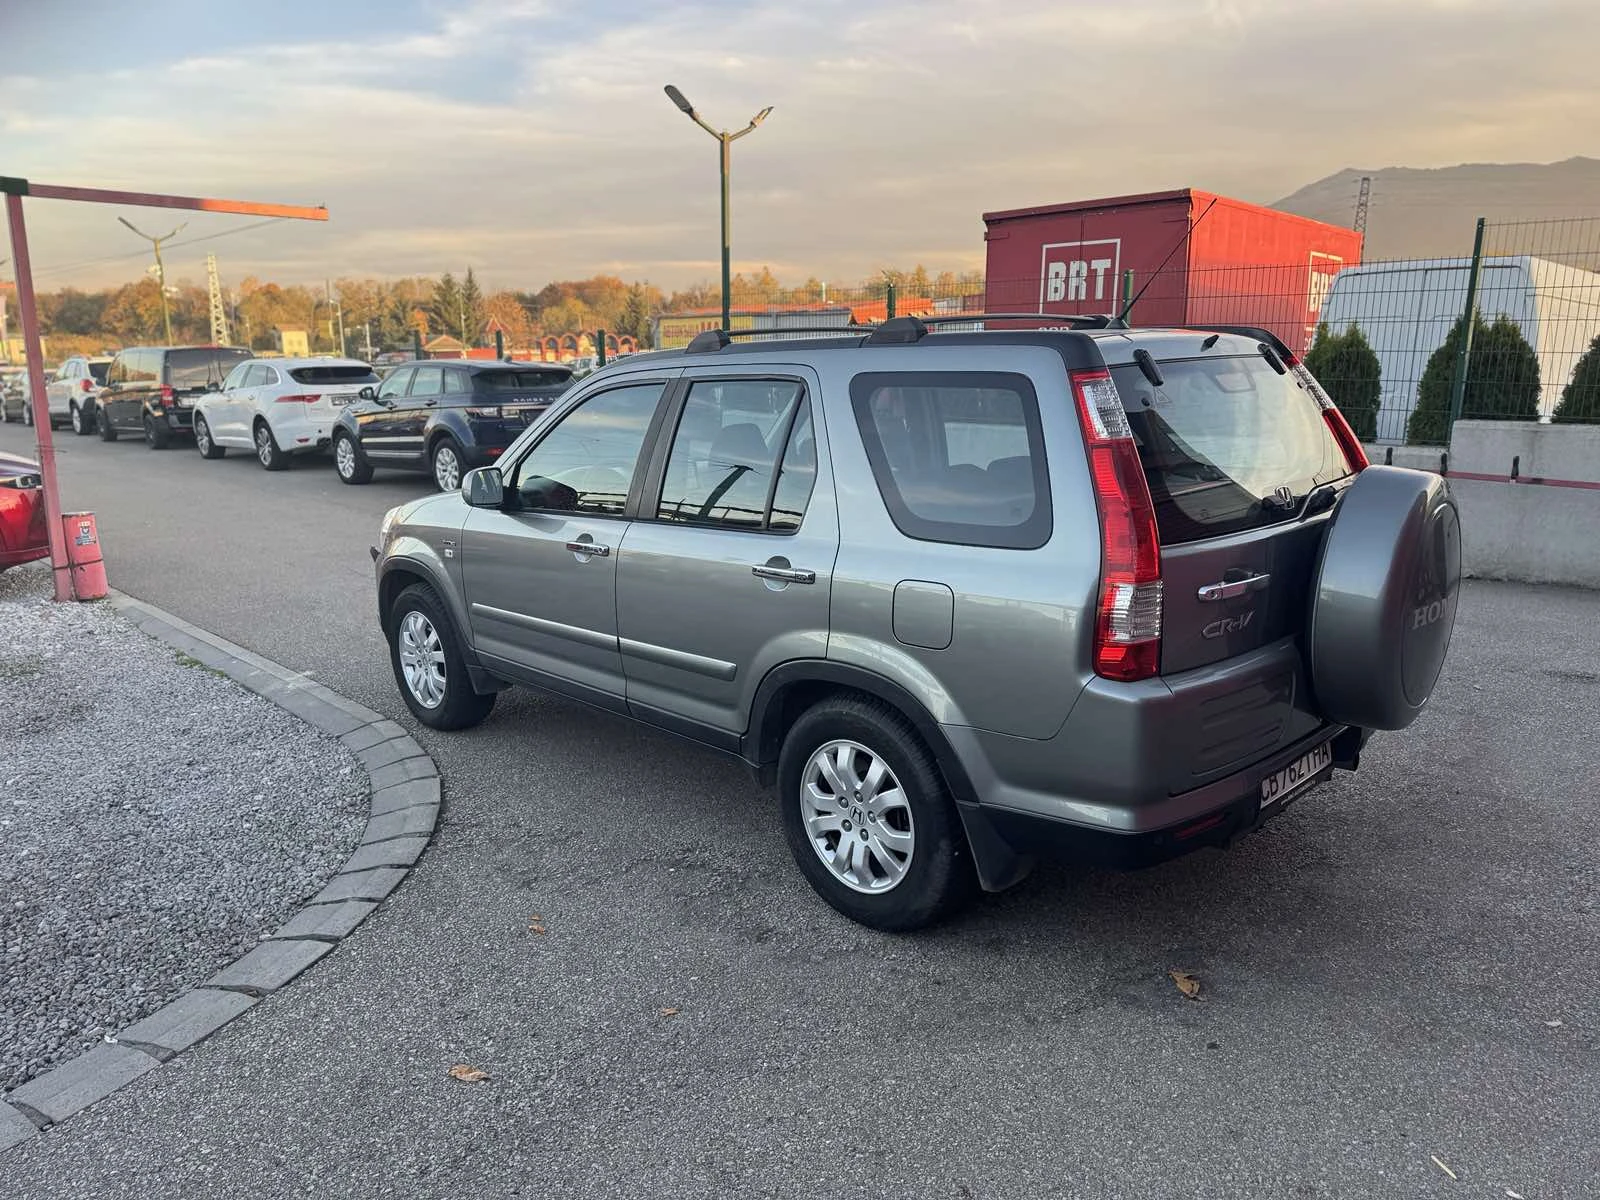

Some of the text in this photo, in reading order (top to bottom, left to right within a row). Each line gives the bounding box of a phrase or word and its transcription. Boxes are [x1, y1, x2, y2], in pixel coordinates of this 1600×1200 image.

[1047, 259, 1112, 302] BRT
[1309, 270, 1336, 313] BR
[1202, 608, 1256, 639] CR-V
[1411, 596, 1453, 631] HON
